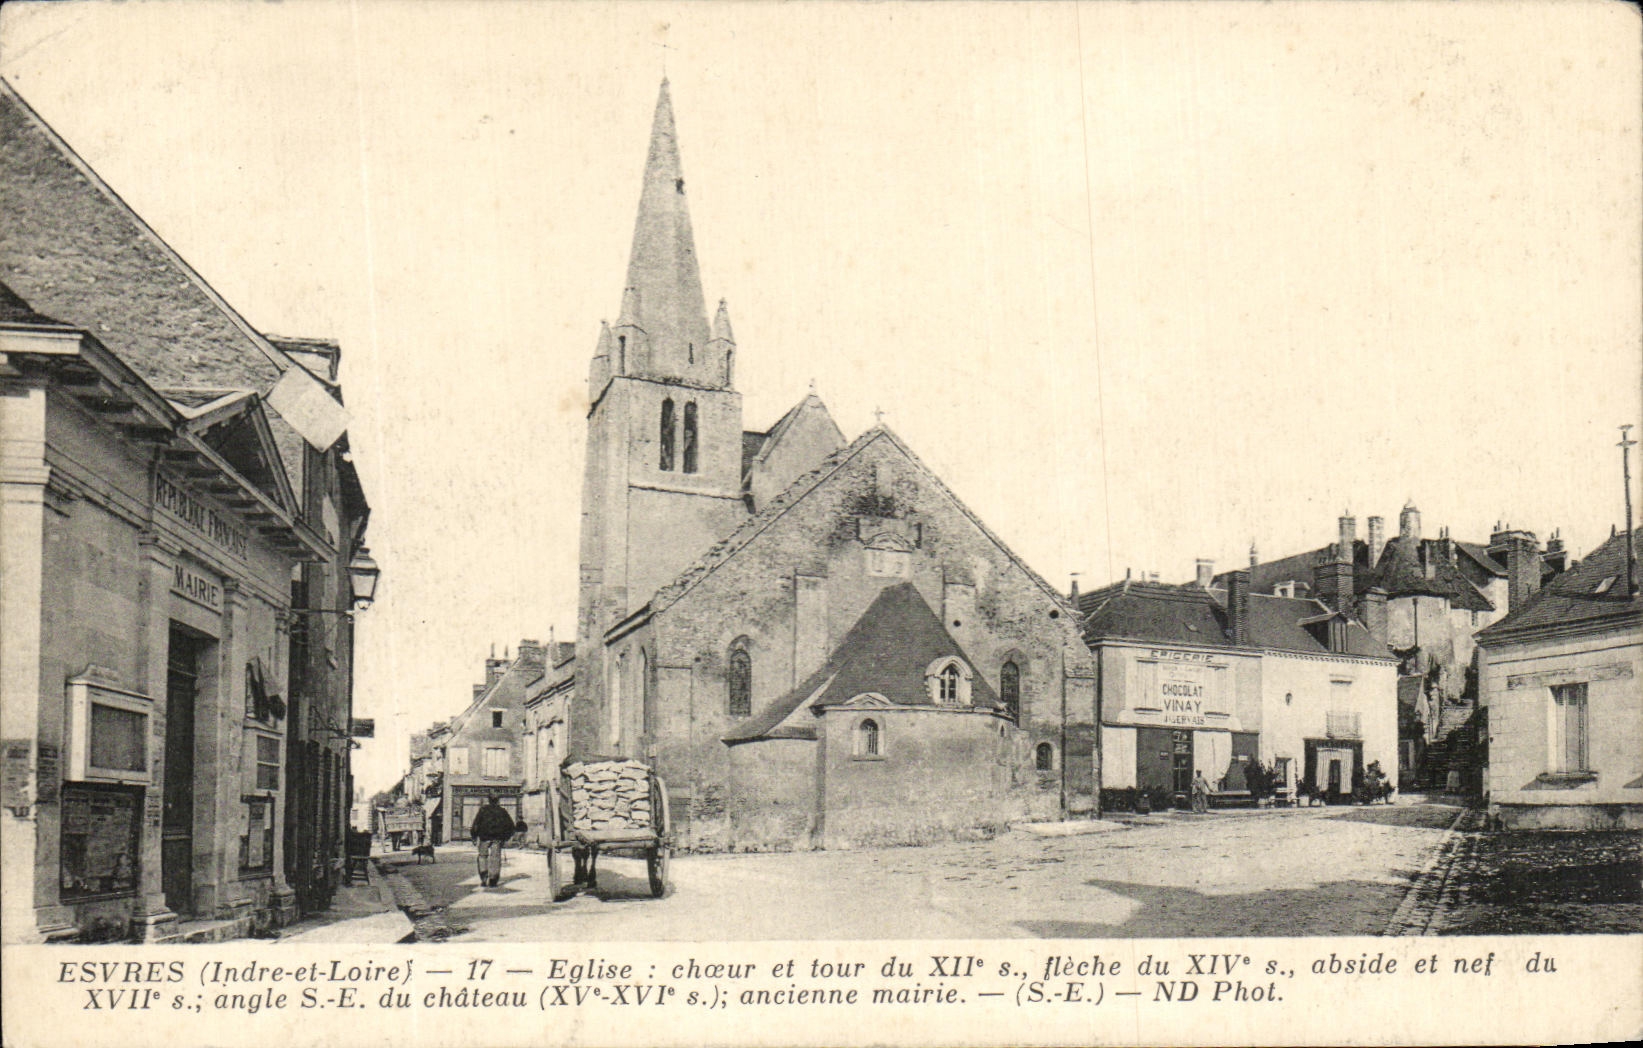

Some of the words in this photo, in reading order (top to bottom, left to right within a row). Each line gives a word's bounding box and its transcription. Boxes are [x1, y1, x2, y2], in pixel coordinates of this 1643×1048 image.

[175, 564, 219, 607] MAIRIE
[1150, 650, 1214, 663] EPICERIE
[1162, 683, 1204, 698] CHOCOLAT
[1163, 699, 1202, 713] VINAY
